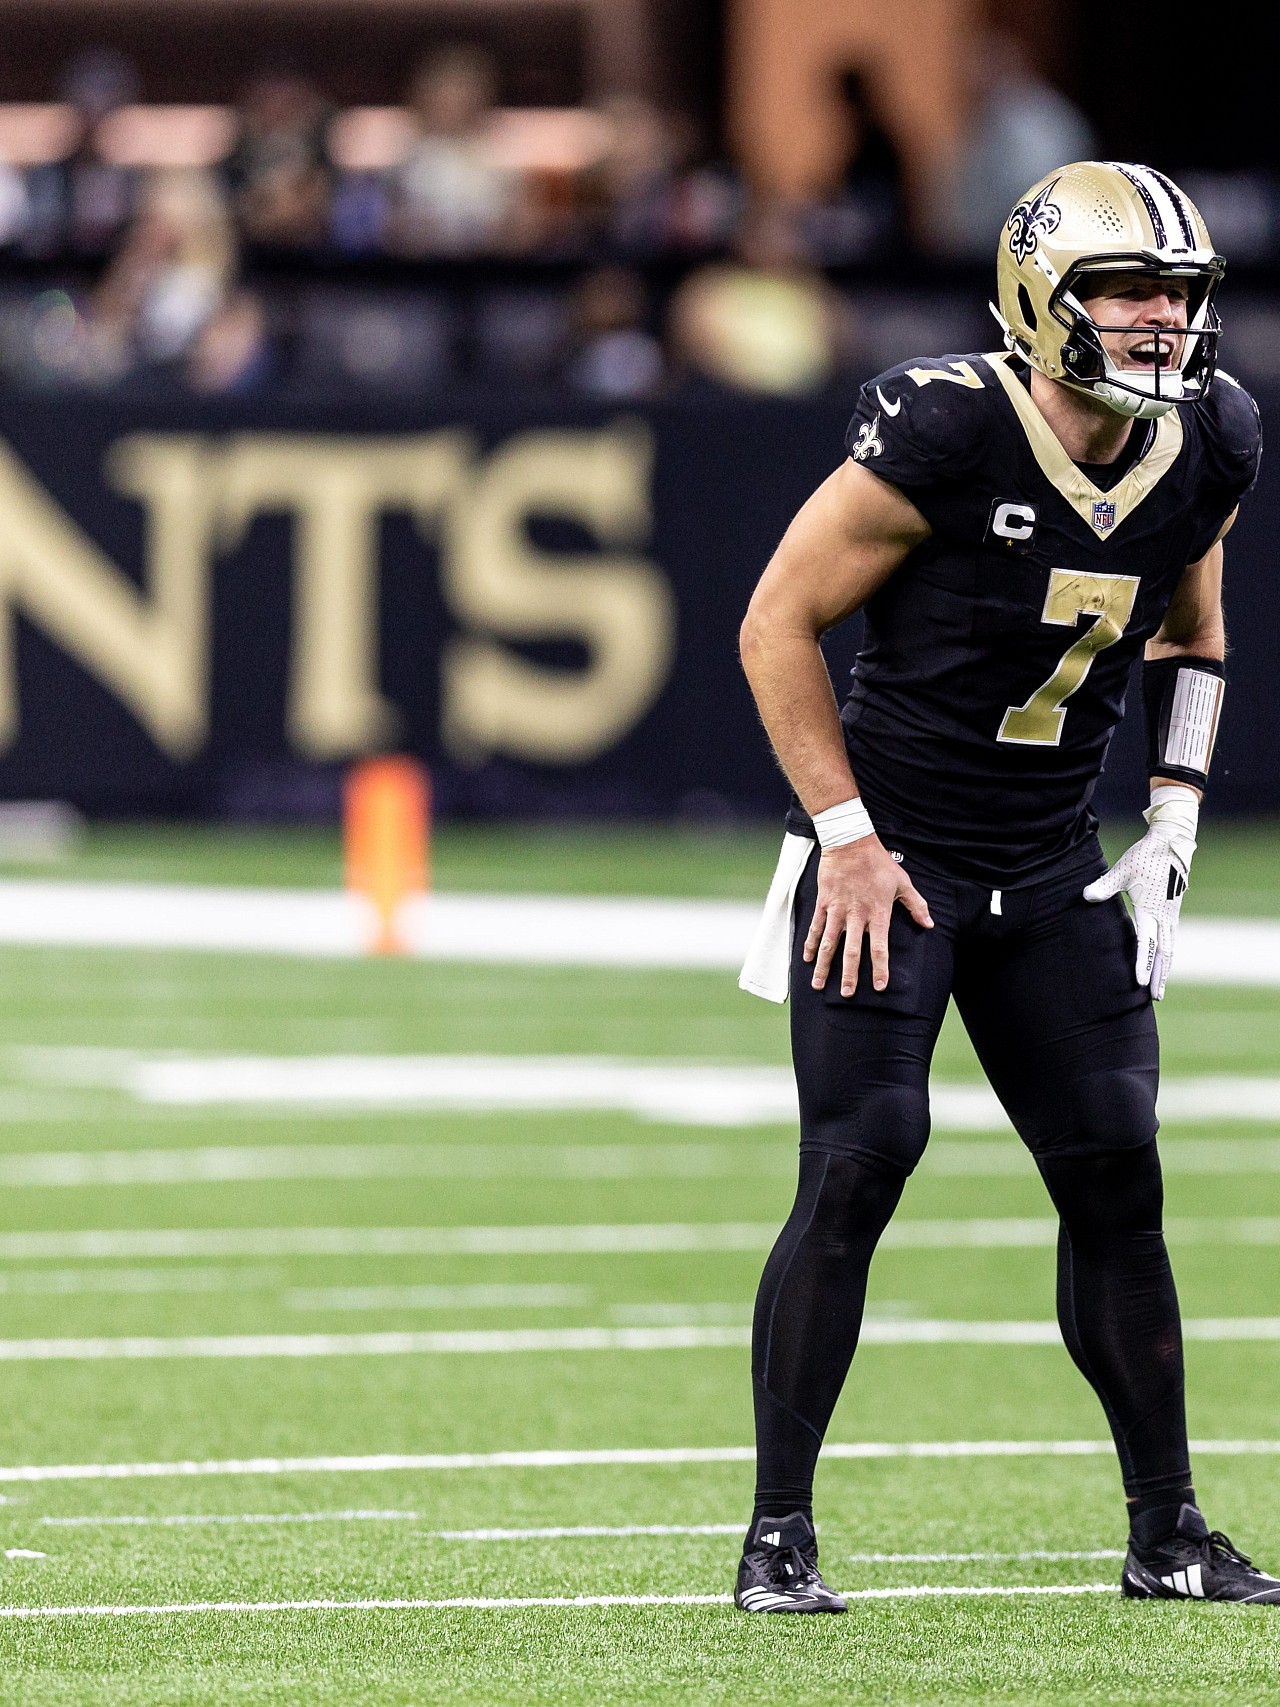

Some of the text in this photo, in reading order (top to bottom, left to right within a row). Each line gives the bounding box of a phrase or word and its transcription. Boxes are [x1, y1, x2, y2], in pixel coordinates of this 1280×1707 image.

[904, 360, 986, 389] 7
[992, 503, 1036, 539] C
[1095, 513, 1113, 526] NFL
[996, 567, 1141, 746] 7
